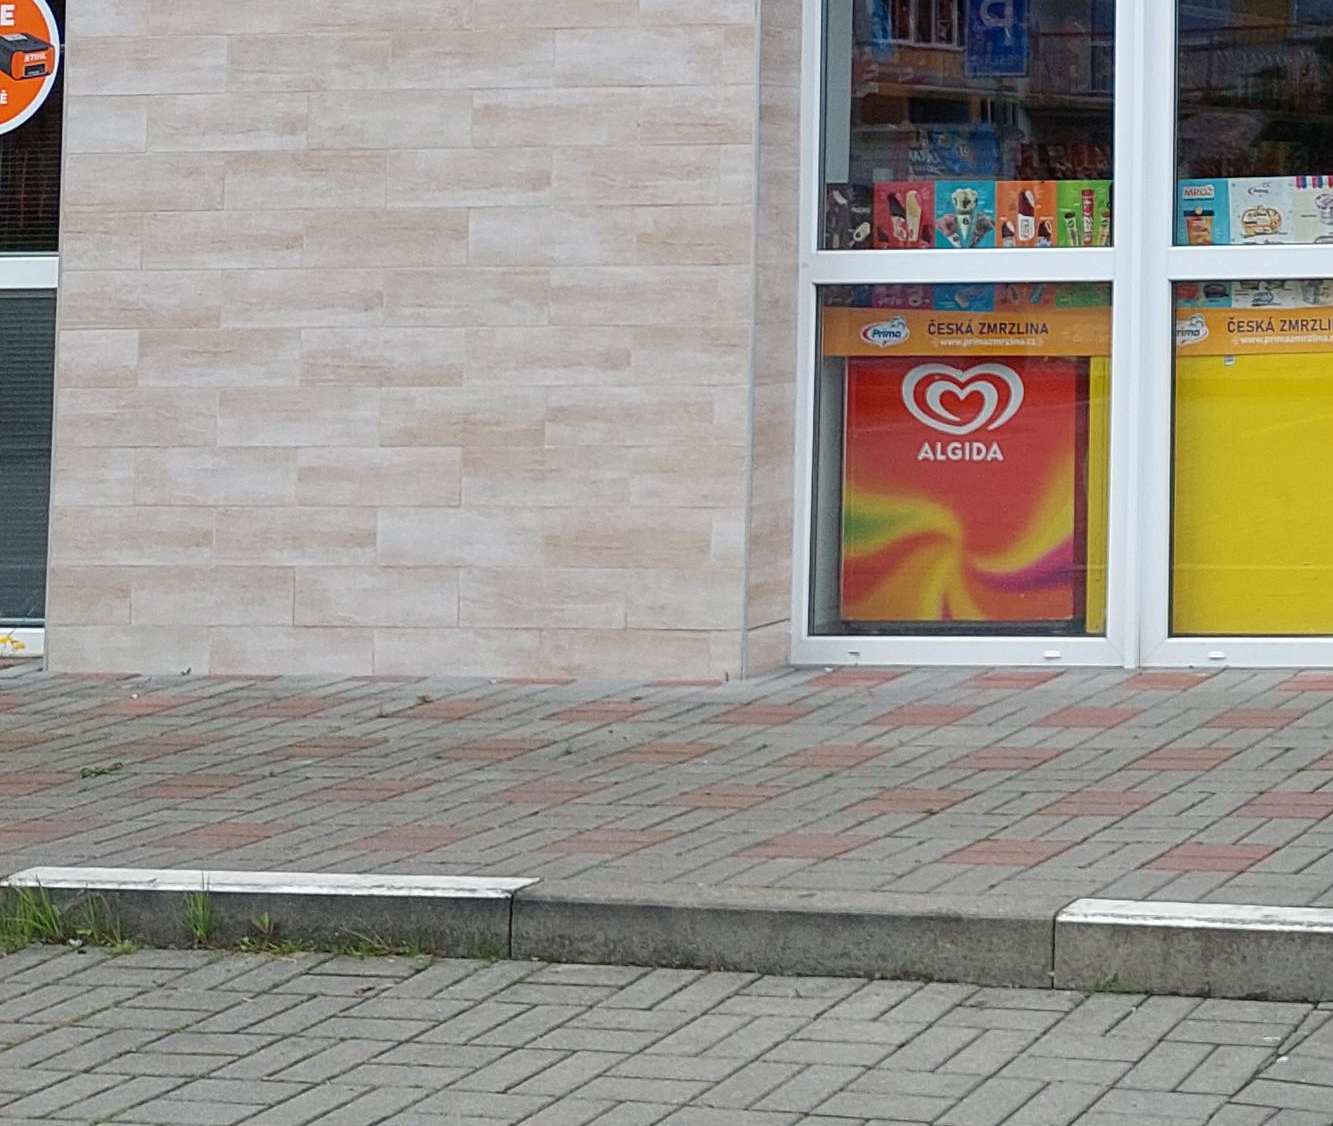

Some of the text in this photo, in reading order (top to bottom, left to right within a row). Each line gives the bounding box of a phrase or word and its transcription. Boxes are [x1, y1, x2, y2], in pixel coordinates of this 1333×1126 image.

[928, 320, 974, 336] ČESKÁ
[978, 323, 1050, 335] ZMRZLINA
[1176, 329, 1201, 338] rima
[1227, 317, 1274, 334] ČESKÁ
[917, 441, 1004, 462] ALGIDA
